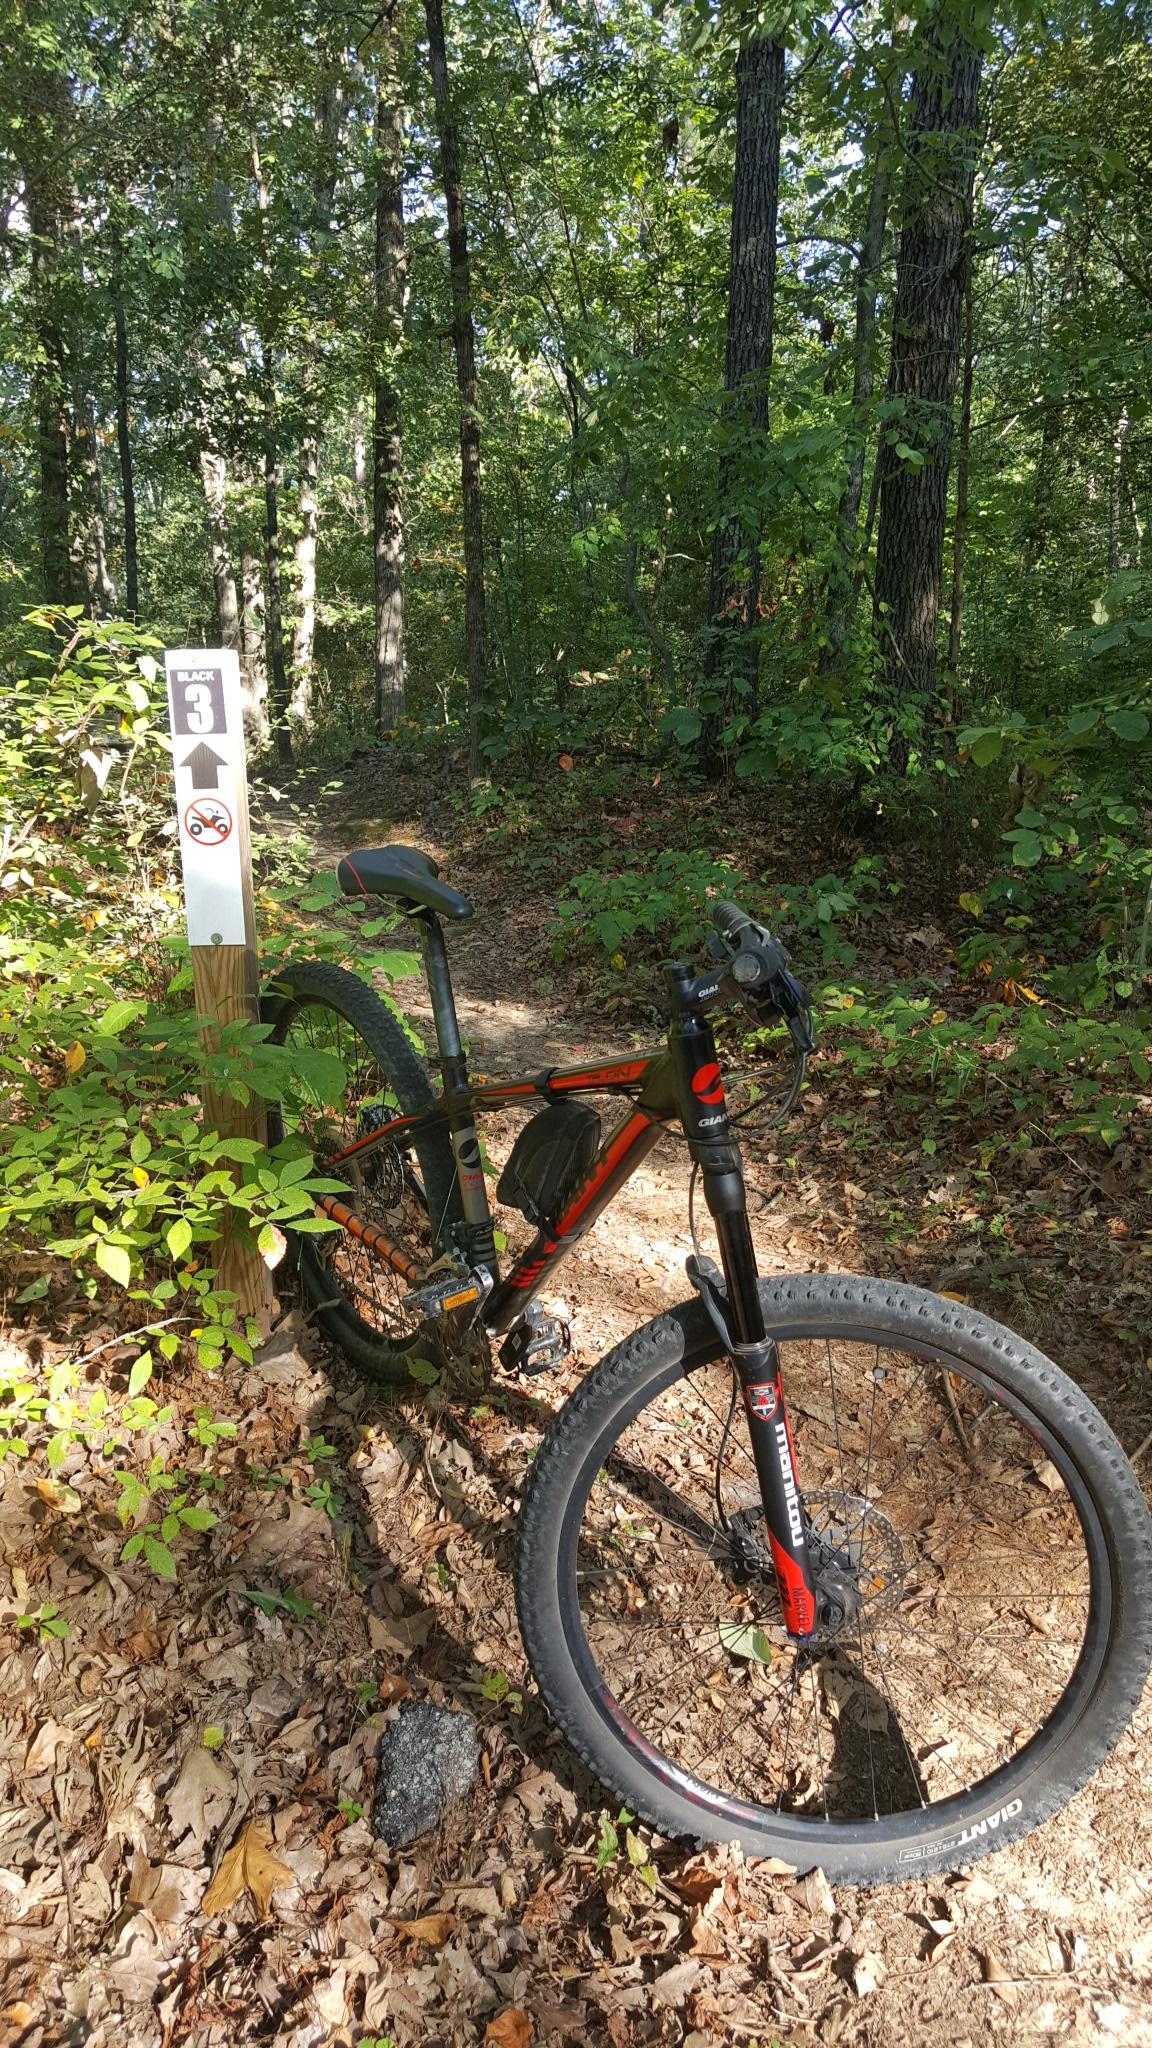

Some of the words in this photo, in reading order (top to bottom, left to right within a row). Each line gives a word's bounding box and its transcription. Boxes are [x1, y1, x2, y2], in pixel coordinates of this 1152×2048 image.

[177, 670, 215, 682] BLACK
[185, 684, 214, 734] 3
[775, 1422, 804, 1547] manitou
[957, 1798, 1023, 1846] GIANT
